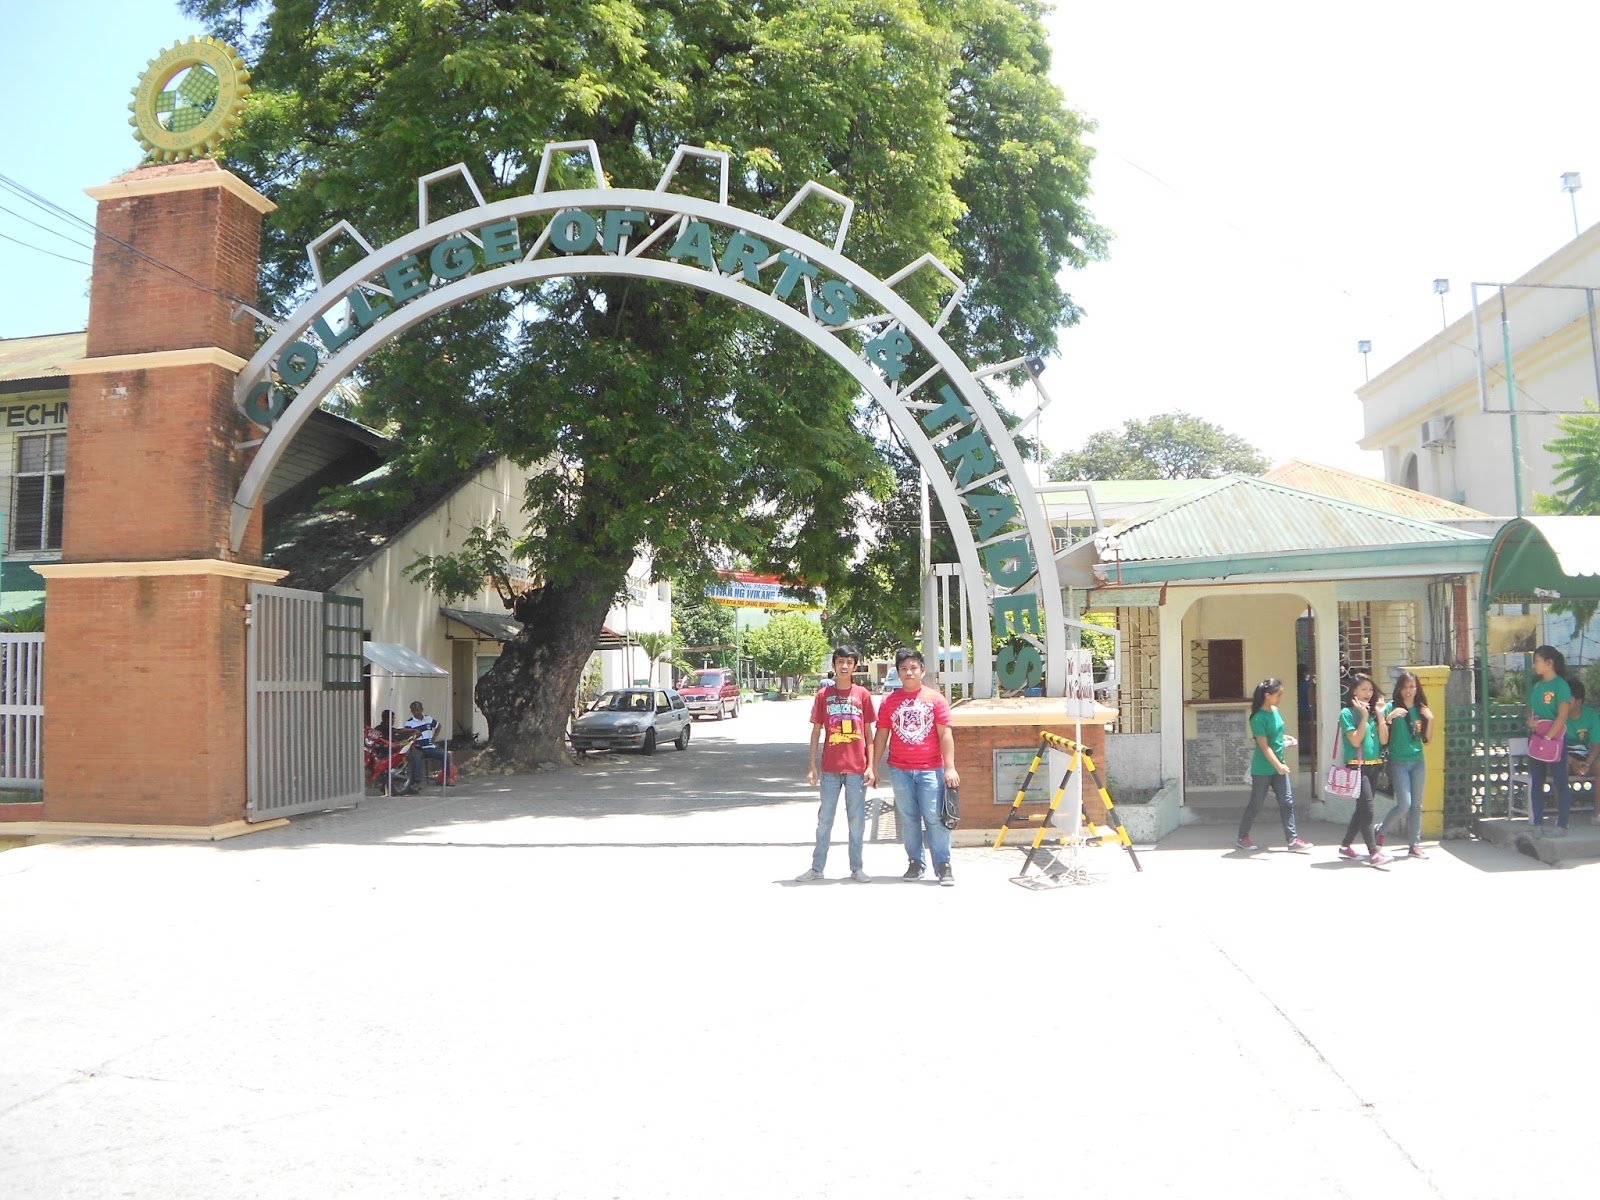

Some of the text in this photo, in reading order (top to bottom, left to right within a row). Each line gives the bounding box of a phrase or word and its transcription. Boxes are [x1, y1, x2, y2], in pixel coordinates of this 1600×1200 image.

[156, 48, 196, 70] COLLEGE
[199, 47, 212, 57] OF
[244, 209, 1042, 690] COLLEGE OF ARTS & TRADES
[734, 588, 746, 598] NG
